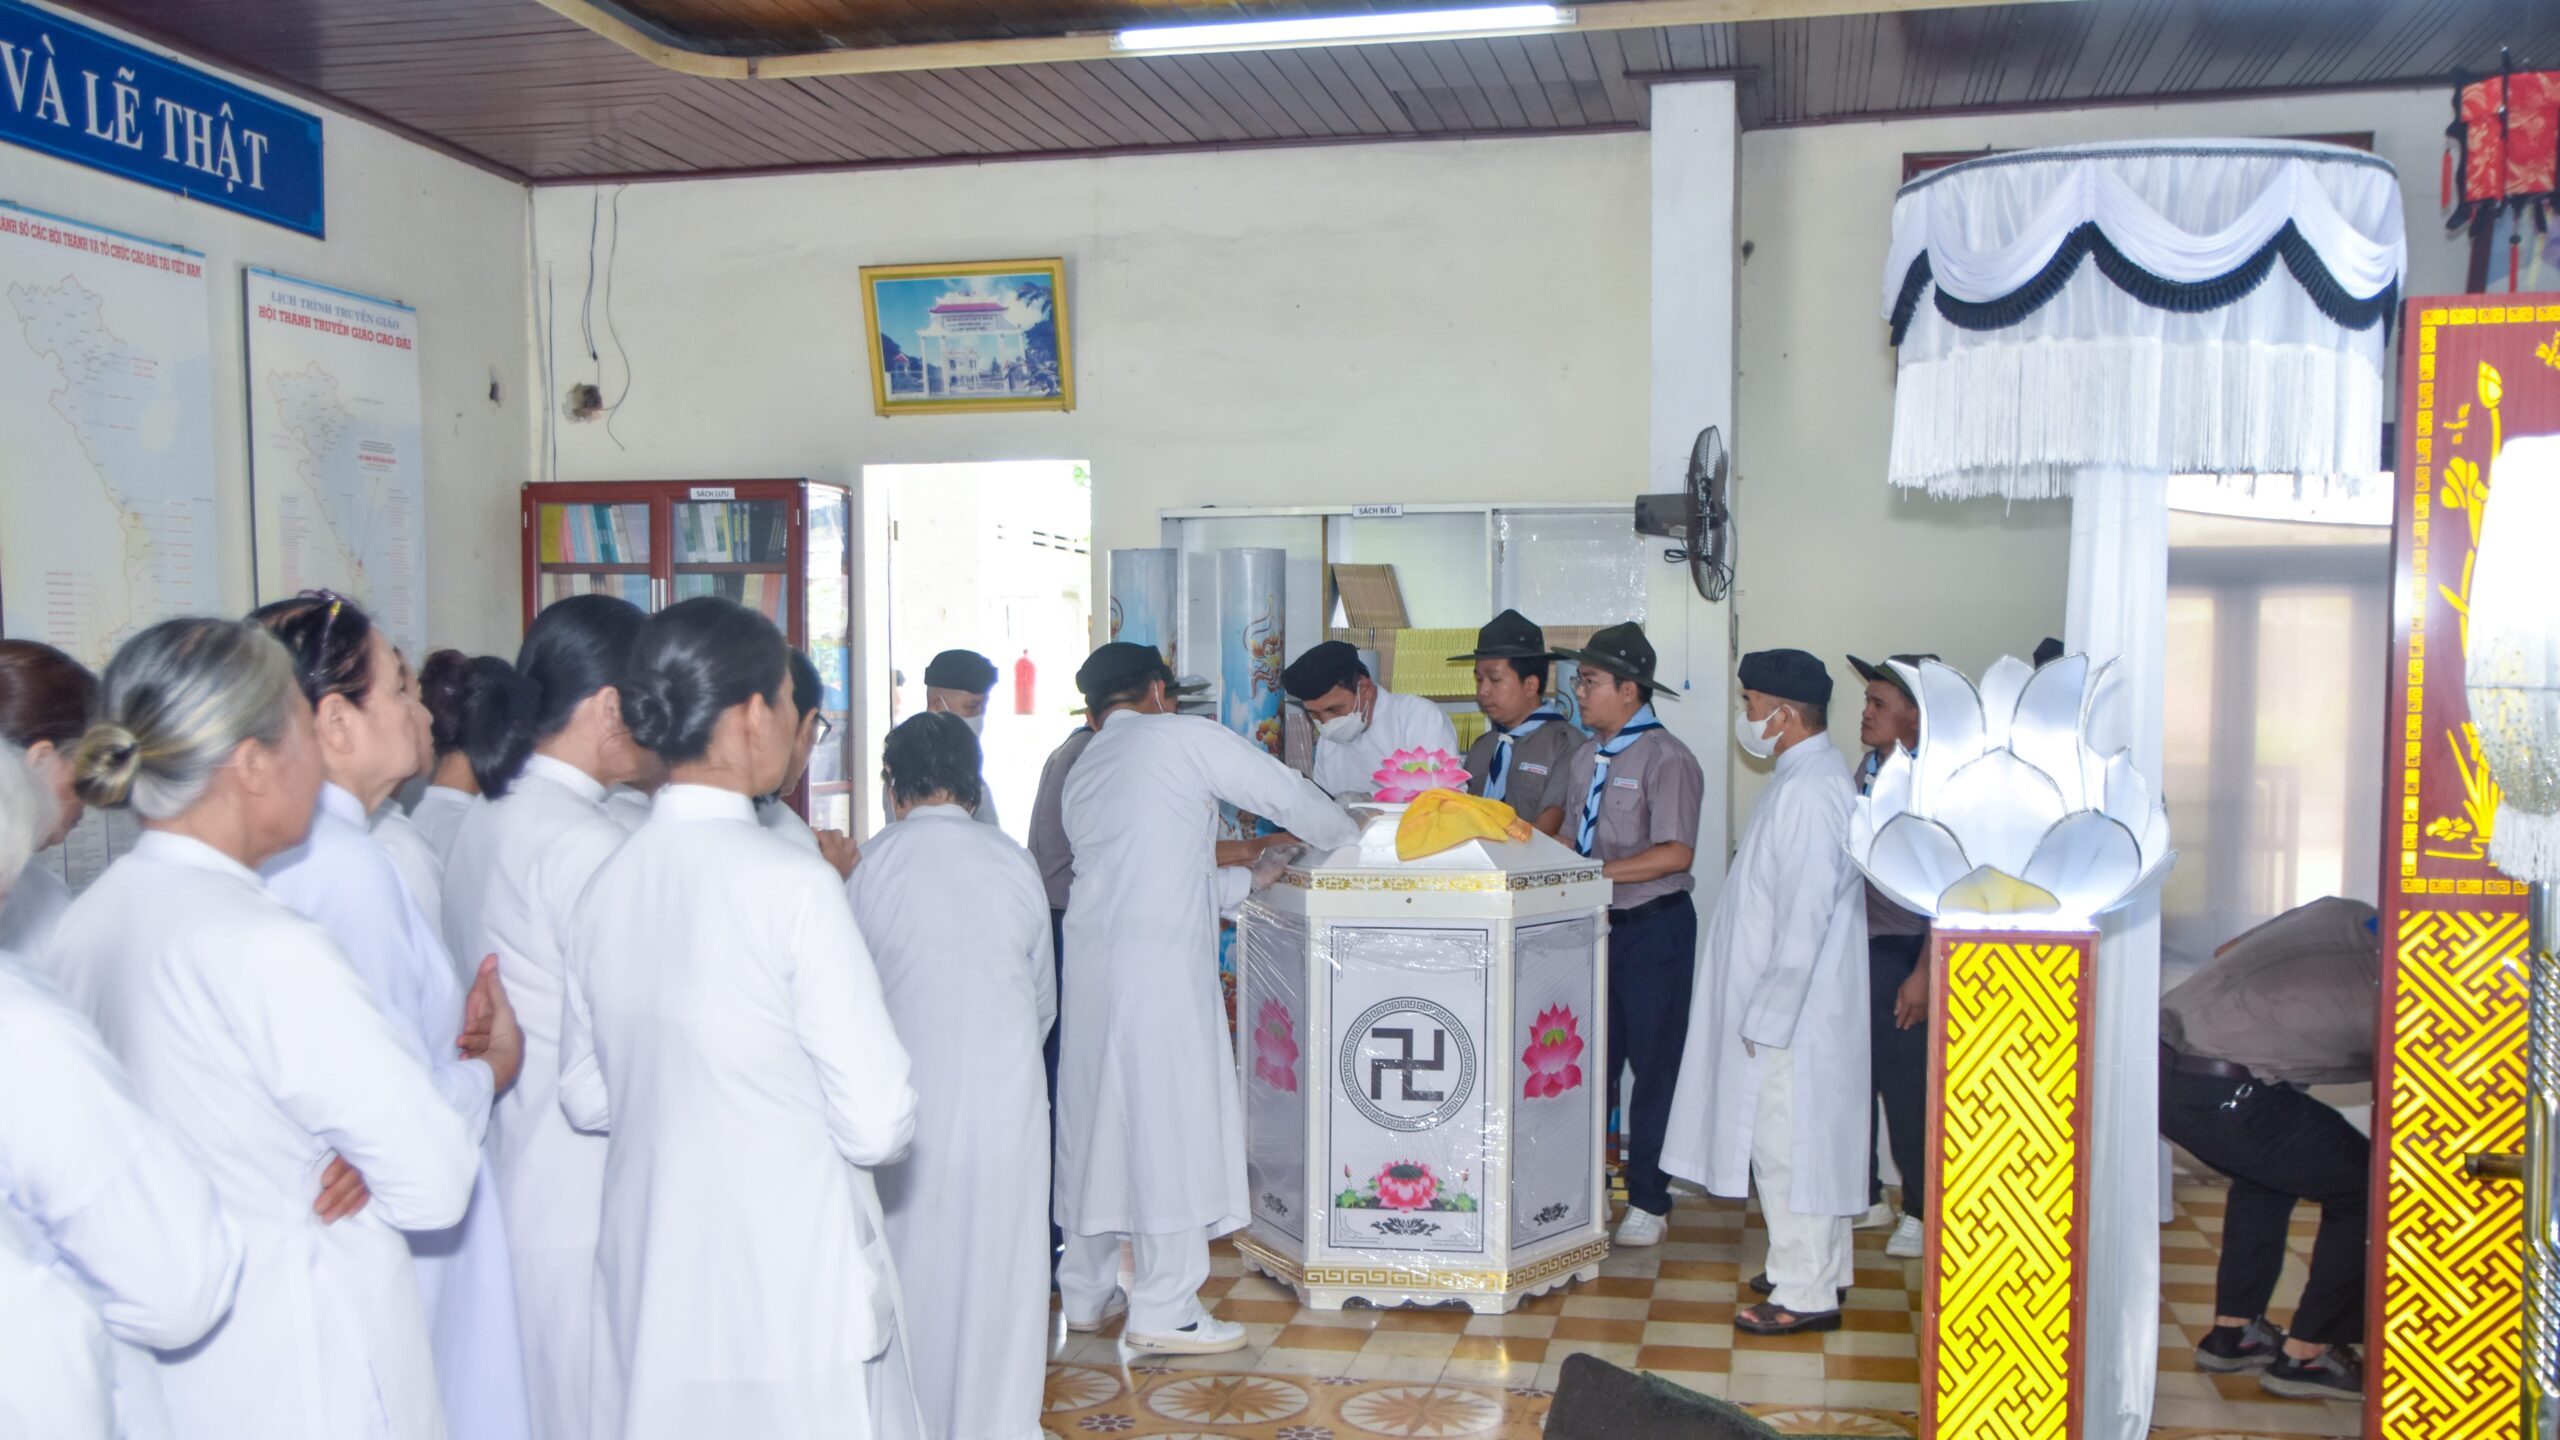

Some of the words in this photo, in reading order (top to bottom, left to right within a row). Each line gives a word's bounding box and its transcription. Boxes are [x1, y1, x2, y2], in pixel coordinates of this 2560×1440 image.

[0, 33, 70, 127] VÀ
[82, 66, 143, 150] LẼ
[155, 102, 268, 193] THẬT
[258, 303, 277, 323] HỘI
[279, 308, 312, 329] THÁNH
[351, 324, 374, 342] GIÁO
[375, 332, 395, 346] CAO
